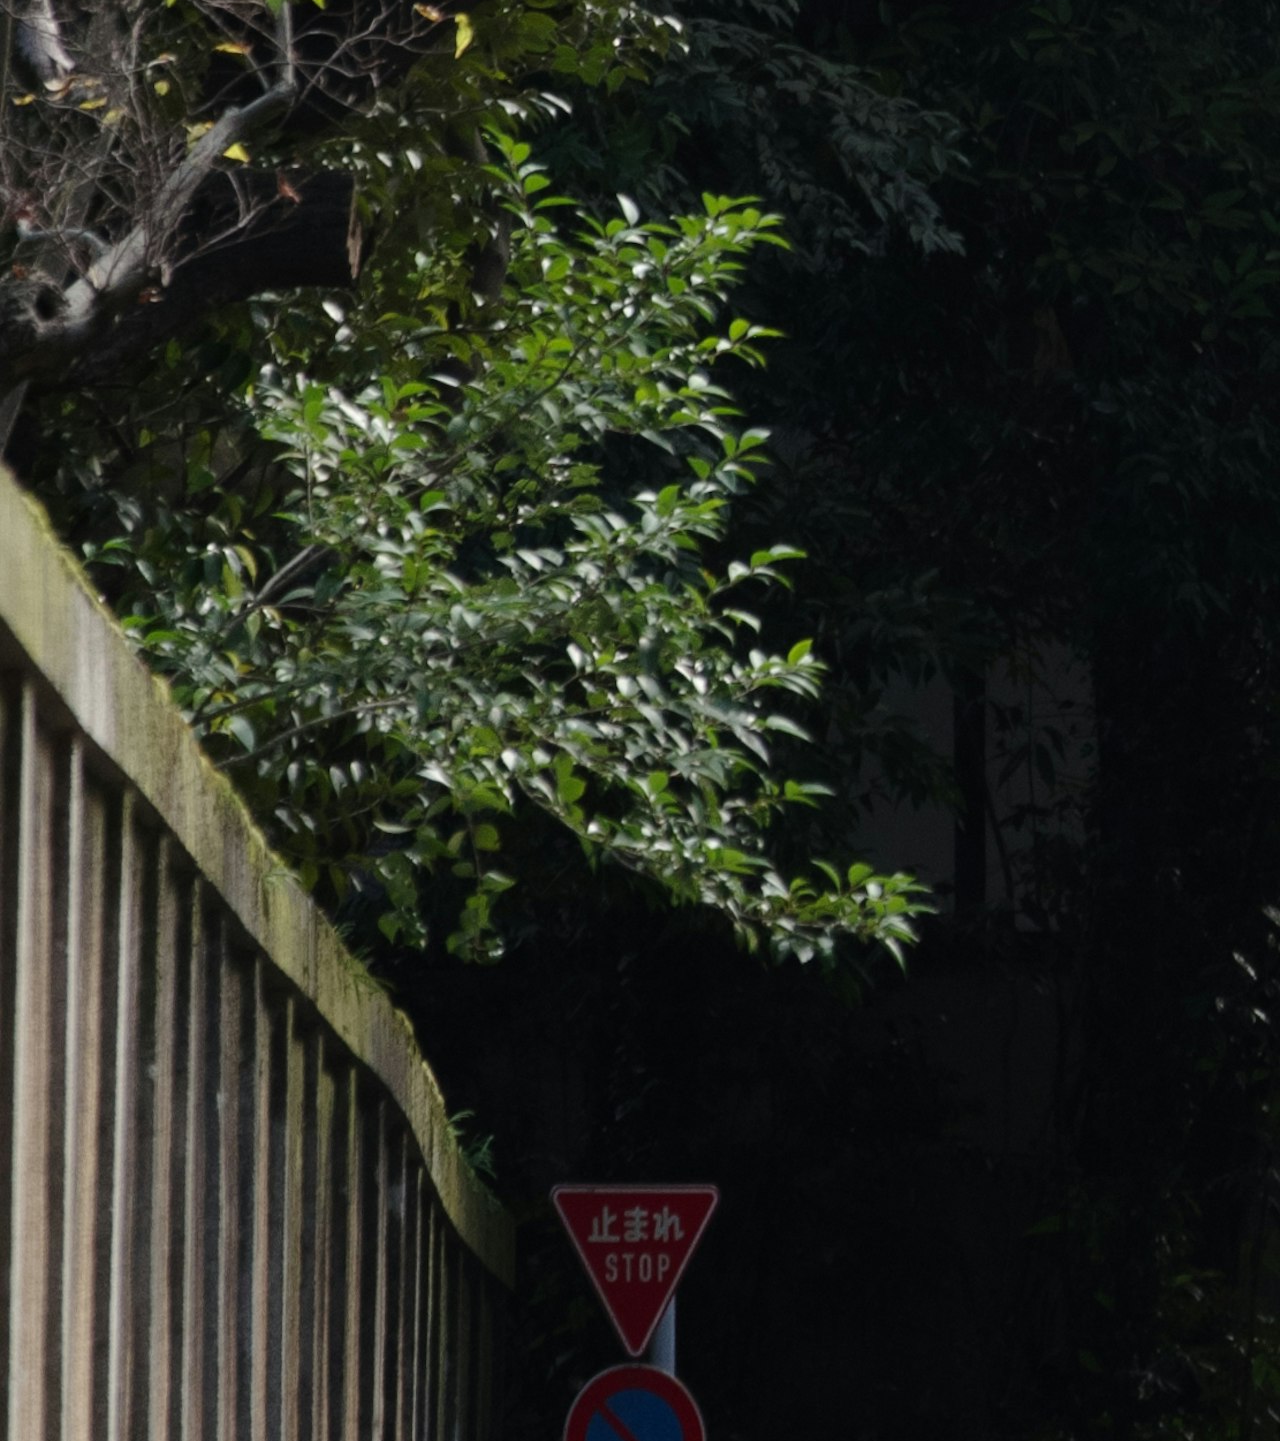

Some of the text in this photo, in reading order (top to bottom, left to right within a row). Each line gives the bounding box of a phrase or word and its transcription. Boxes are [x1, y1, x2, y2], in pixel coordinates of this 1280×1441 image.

[588, 1205, 684, 1242] 止まれ
[605, 1253, 671, 1282] STOP
